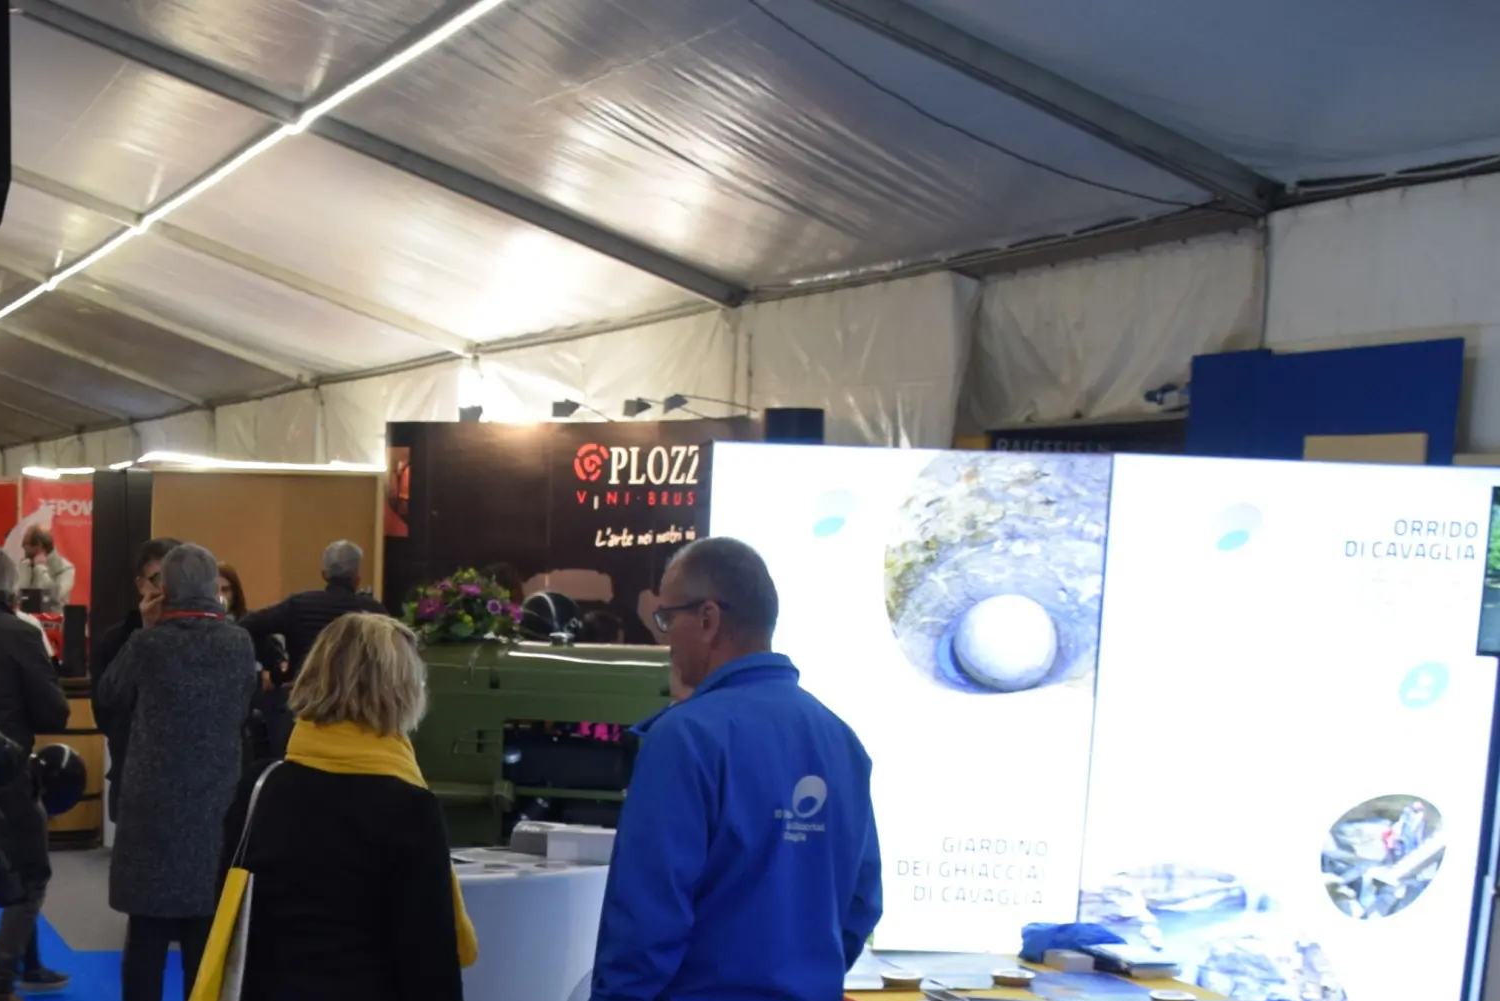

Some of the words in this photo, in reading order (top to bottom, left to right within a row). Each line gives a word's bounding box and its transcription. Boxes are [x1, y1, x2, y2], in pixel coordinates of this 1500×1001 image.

[608, 445, 700, 485] PLOZZ
[1394, 519, 1479, 538] ORRIDO
[1345, 540, 1364, 558] DI
[1372, 541, 1476, 560] CAVAGLIA
[942, 836, 1048, 857] GIARDINO
[897, 860, 930, 878] DEI
[939, 861, 1045, 880] GHIACCIAI
[914, 885, 932, 901] DI
[941, 886, 1043, 906] CAVAGLIA
